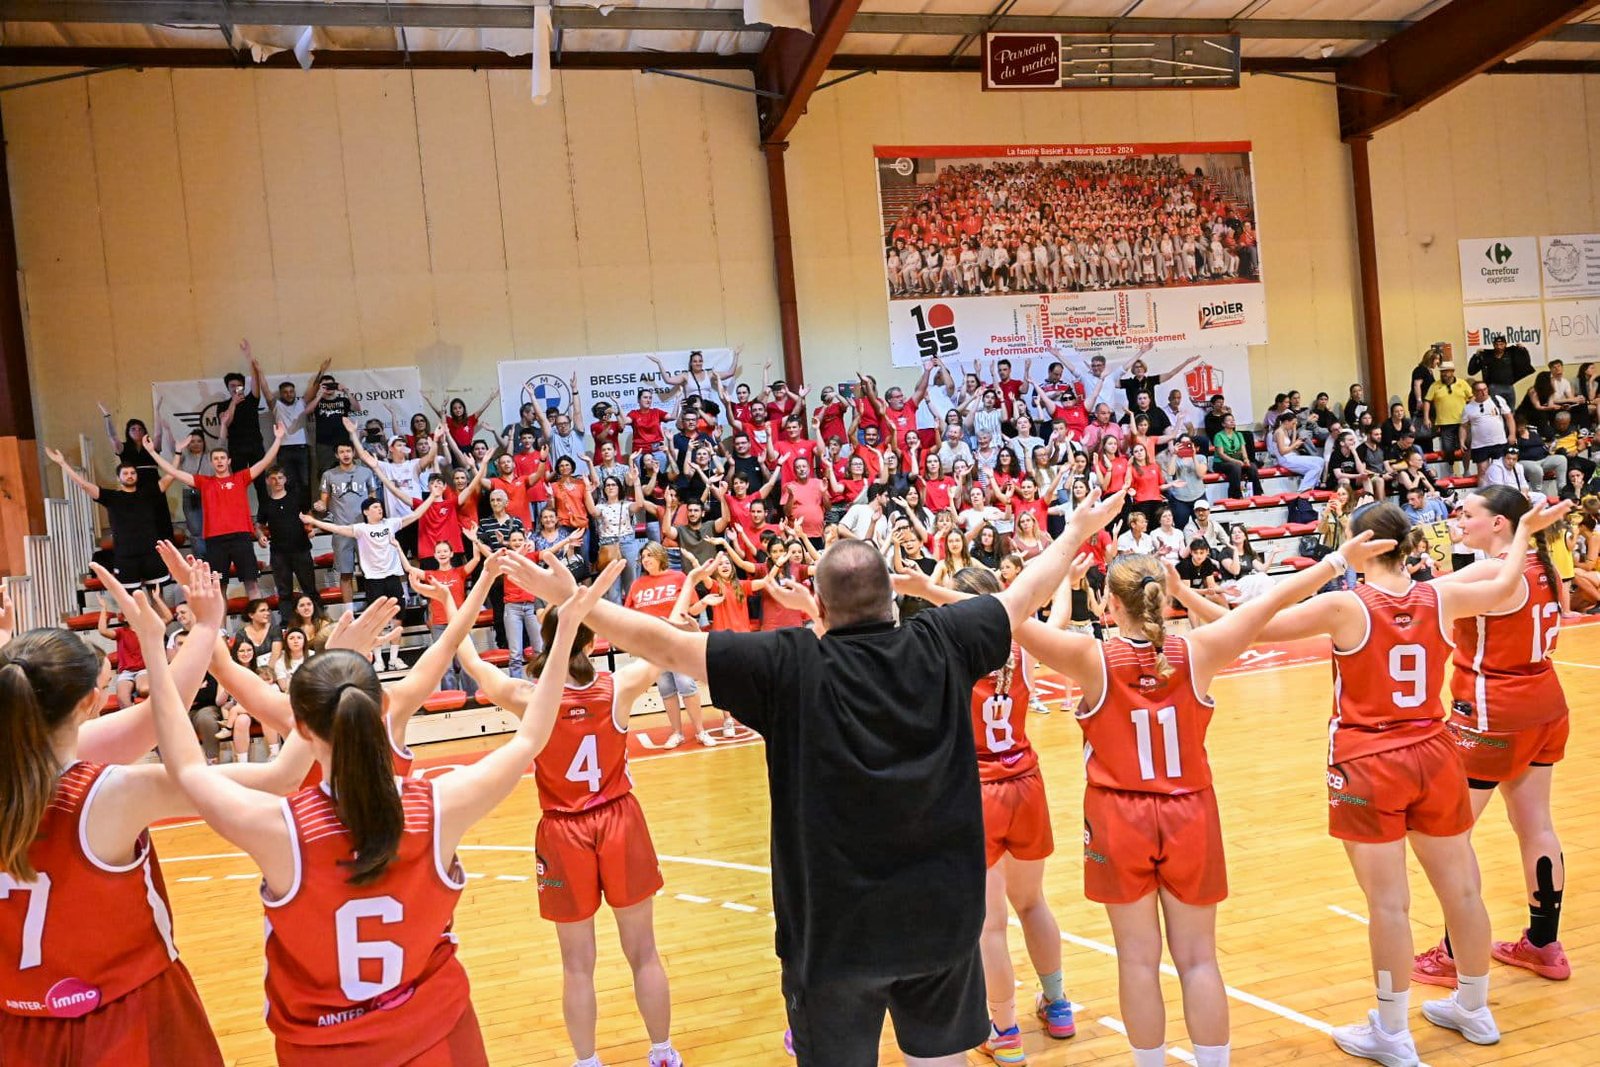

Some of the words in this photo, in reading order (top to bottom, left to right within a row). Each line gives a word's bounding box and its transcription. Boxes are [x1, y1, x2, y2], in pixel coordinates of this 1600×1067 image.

[994, 43, 1047, 64] Parrain
[1000, 67, 1016, 80] du
[1022, 54, 1058, 74] match
[1040, 147, 1064, 155] Basket
[1074, 147, 1094, 156] Bourg
[1481, 267, 1519, 276] Carrefour
[1487, 276, 1515, 284] express
[1118, 292, 1127, 337] Tolérance
[1202, 301, 1244, 316] DIDIER
[1040, 295, 1053, 347] Famille
[1068, 315, 1096, 324] Équipe
[991, 334, 1026, 343] Passion
[1054, 323, 1119, 340] Respect
[1126, 333, 1186, 344] Dépassement
[1506, 326, 1541, 344] Rotary
[984, 346, 1044, 356] Performance
[590, 373, 636, 386] BRESSE
[366, 389, 404, 400] SPORT
[592, 388, 620, 398] Bourg
[635, 584, 677, 604] 1975
[1530, 602, 1560, 662] 12
[1388, 643, 1427, 708] 9
[982, 696, 1016, 753] 8
[1130, 706, 1182, 780] 11
[564, 734, 602, 792] 4
[335, 896, 404, 1002] 6
[52, 990, 97, 1008] immo
